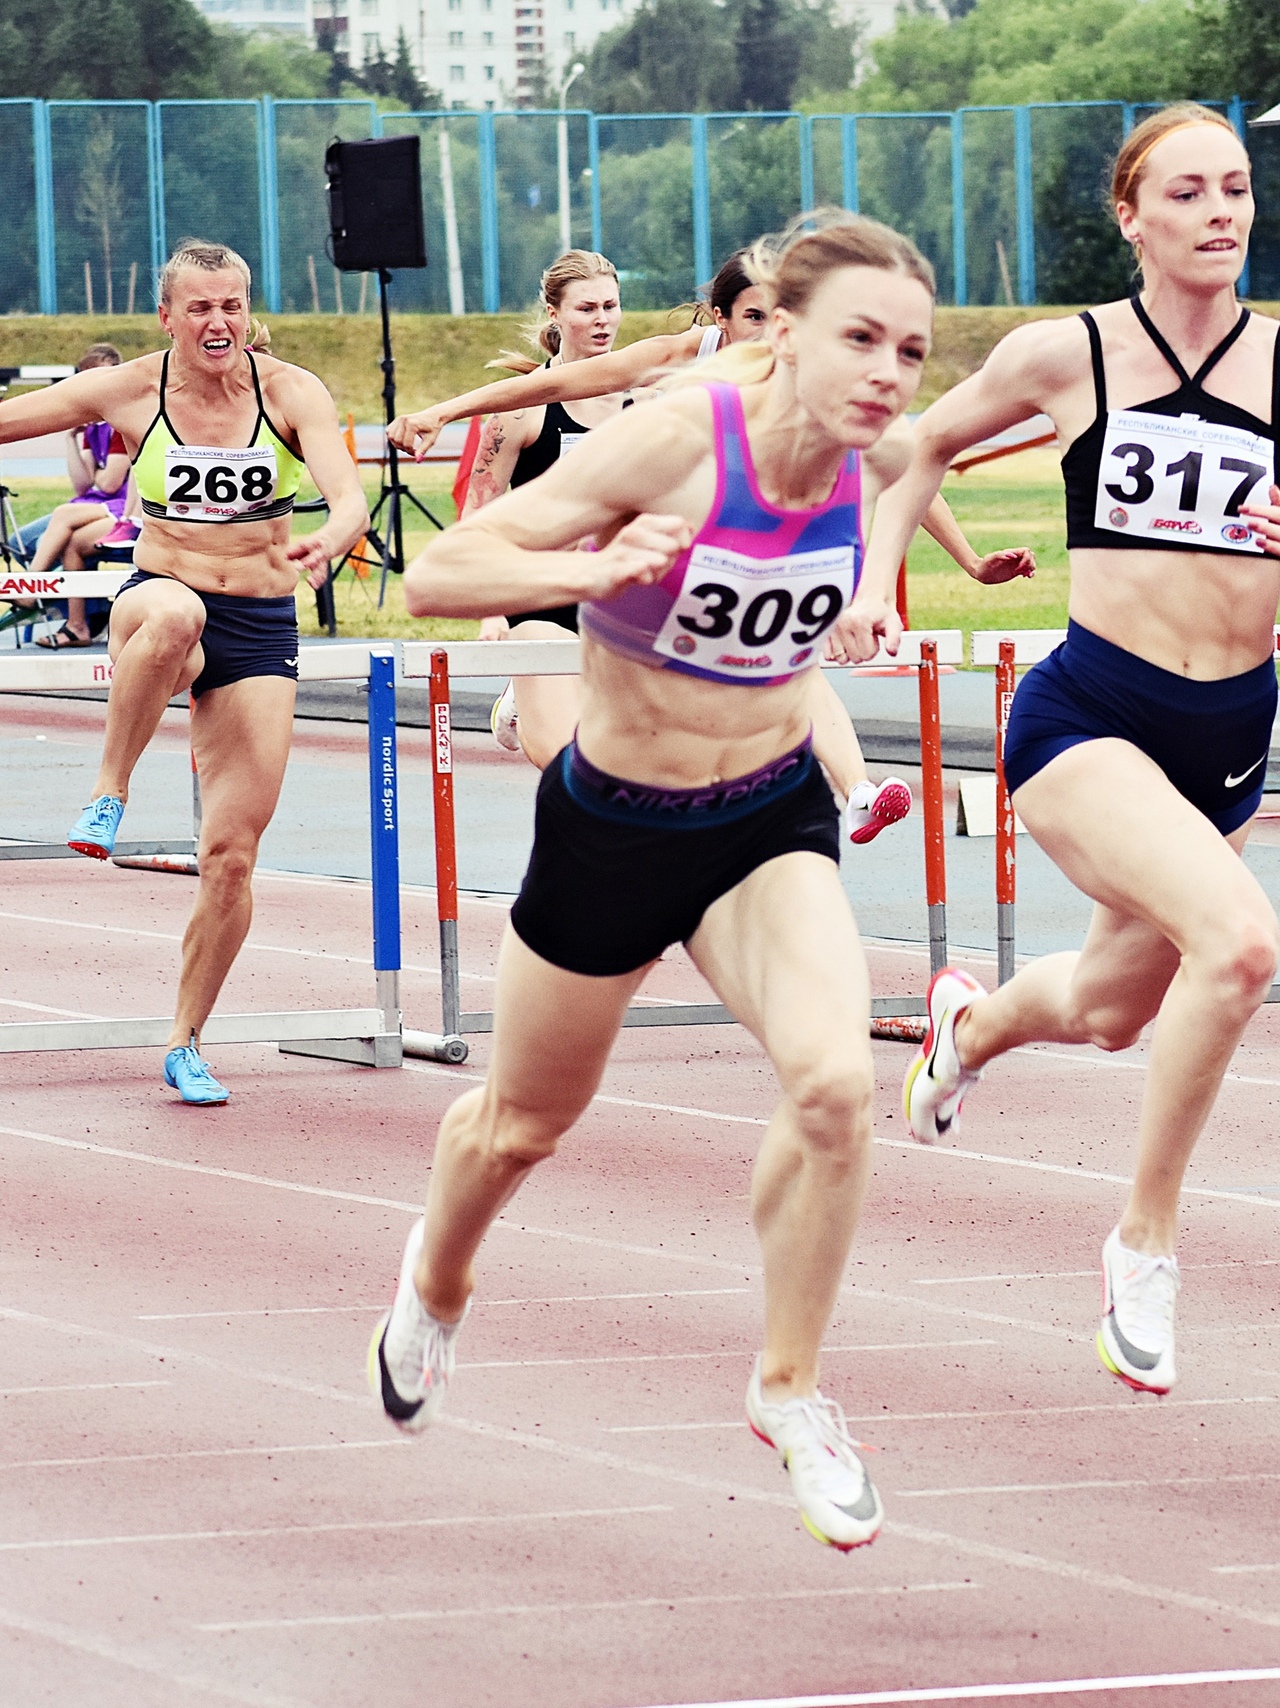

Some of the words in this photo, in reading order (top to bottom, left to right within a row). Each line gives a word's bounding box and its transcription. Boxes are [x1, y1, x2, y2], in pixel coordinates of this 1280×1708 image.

[168, 465, 273, 503] 268
[1104, 442, 1267, 518] 317
[676, 582, 844, 647] 309
[382, 737, 394, 785] nordic
[610, 786, 717, 812] NIKE
